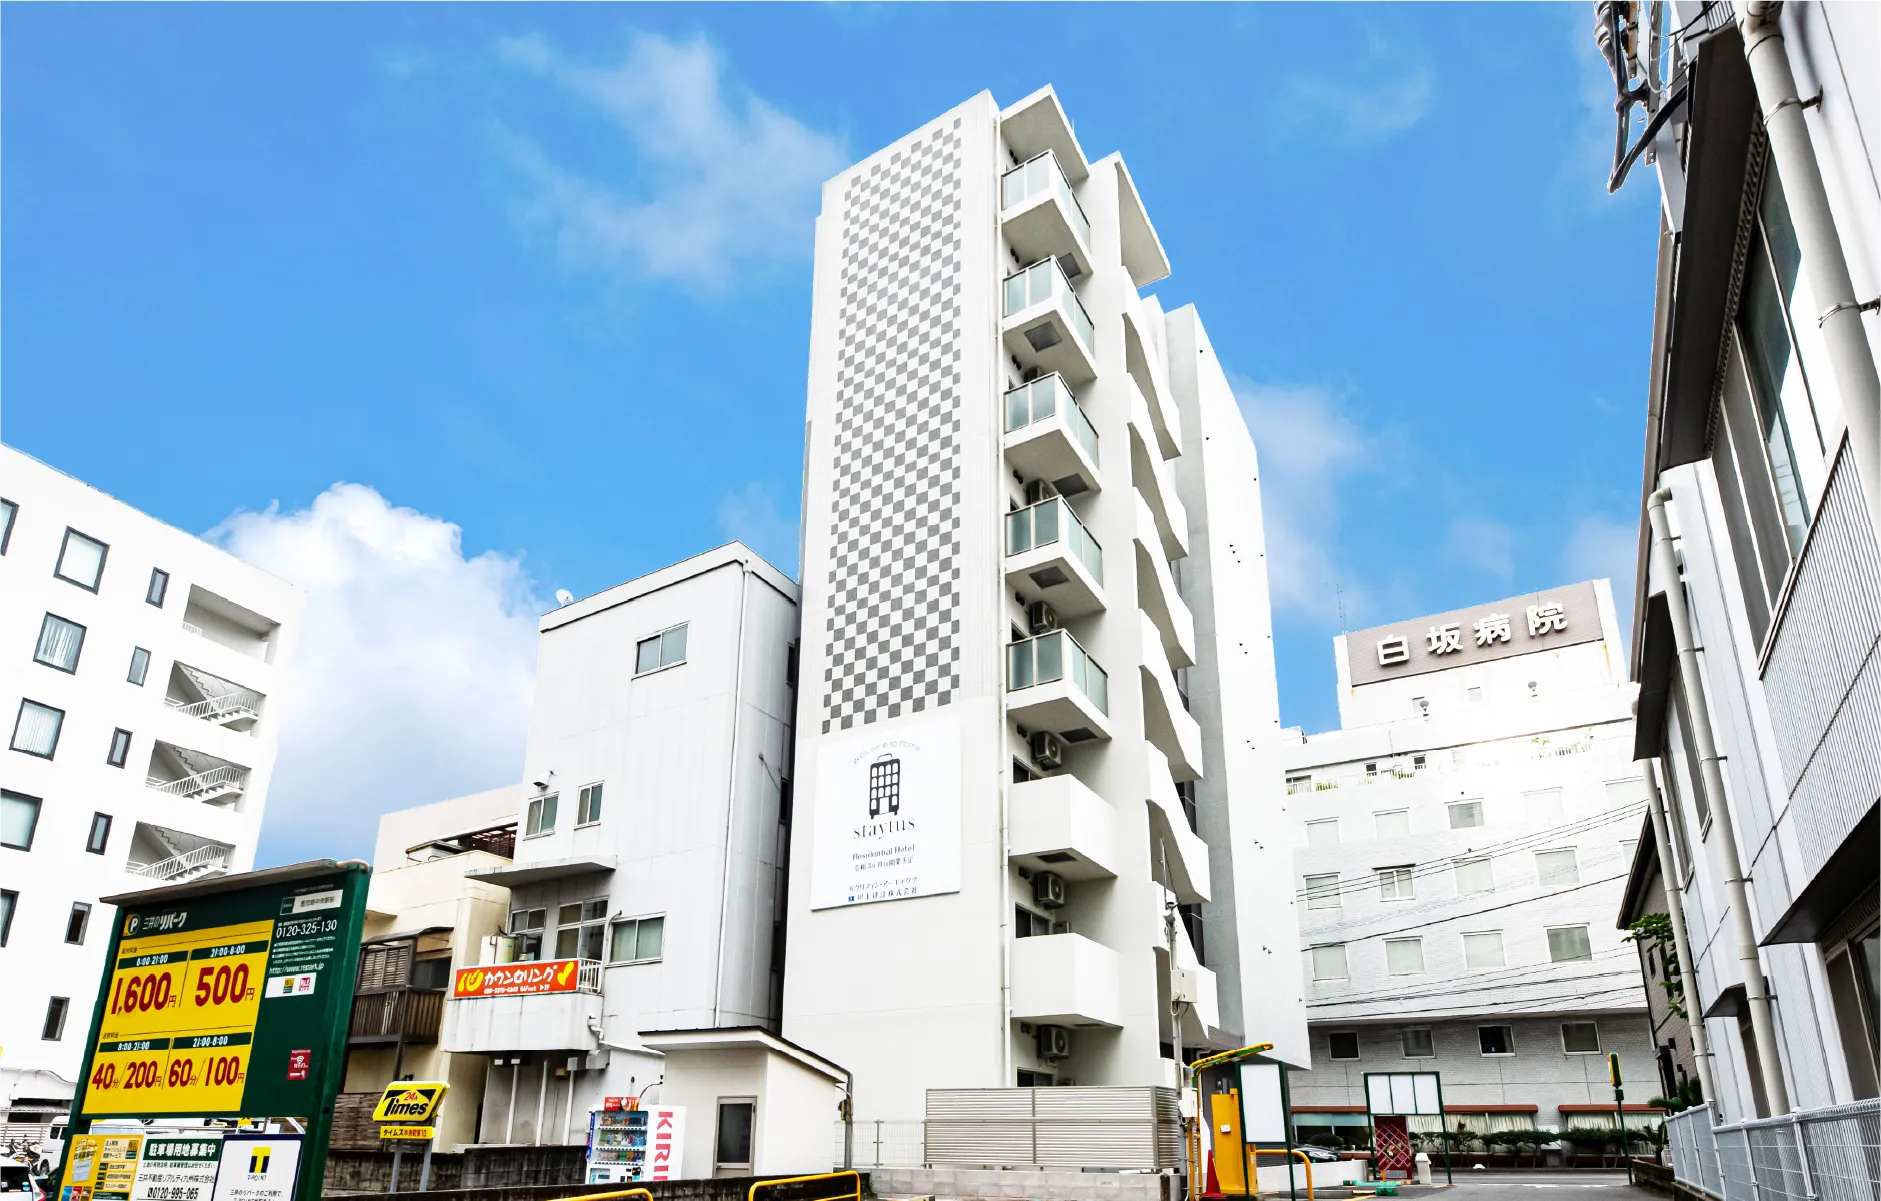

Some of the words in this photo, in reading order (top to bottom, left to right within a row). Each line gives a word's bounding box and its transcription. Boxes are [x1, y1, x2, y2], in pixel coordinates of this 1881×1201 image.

[1376, 602, 1568, 666] 白坂病院
[852, 742, 888, 764] Welcome
[889, 740, 898, 748] to
[852, 847, 892, 860] Residential
[894, 844, 915, 854] Hotel
[143, 912, 188, 930] 三井のリパーク
[276, 919, 338, 938] 0120-325-130
[210, 944, 246, 958] 21:00-8:00
[269, 961, 325, 974] http://www.repark.jp
[111, 971, 177, 1016] 1,600円
[195, 963, 255, 1007] 500円
[193, 1035, 229, 1048] 21:00-8:00
[383, 1097, 429, 1116] Times
[148, 1142, 216, 1157] 駐車場用地募集中
[653, 1111, 674, 1181] KIRI
[138, 1173, 215, 1183] 三井不動産リアルティ九州株式会社
[152, 1187, 200, 1199] 0120-995-065
